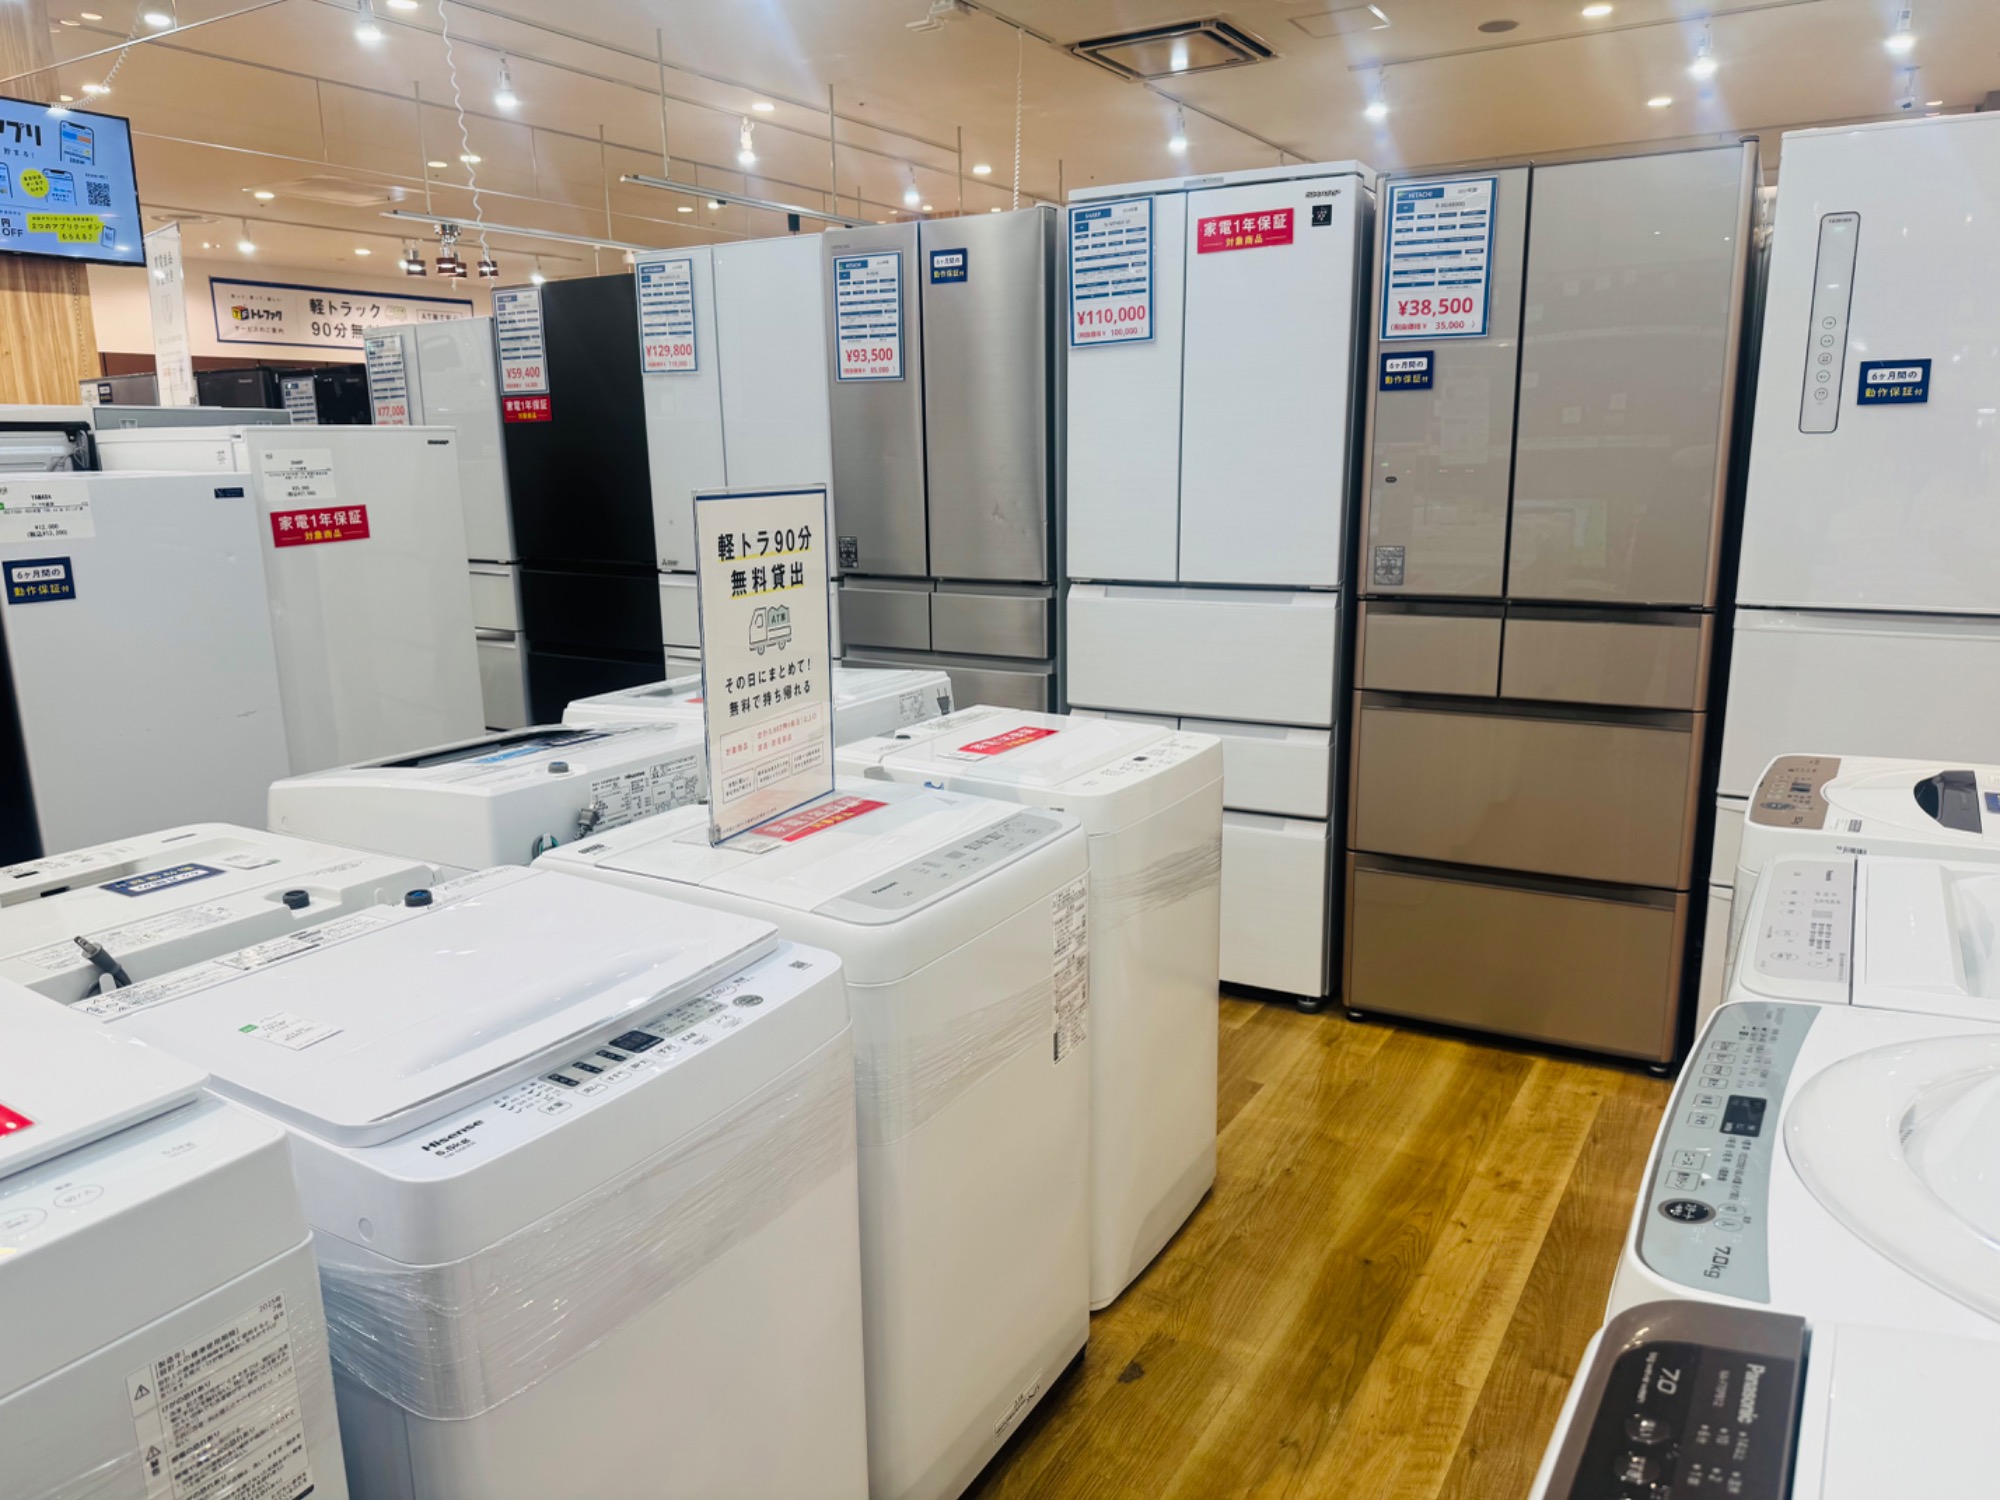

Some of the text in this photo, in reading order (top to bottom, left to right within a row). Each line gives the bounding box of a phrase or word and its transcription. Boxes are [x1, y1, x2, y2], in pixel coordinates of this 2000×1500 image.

[0, 119, 41, 146] プリ
[2, 228, 23, 237] OFF
[1203, 213, 1287, 237] 家電1年保証
[1225, 234, 1263, 247] 対象商品
[309, 298, 381, 318] 軽トラック
[1077, 305, 1146, 326] ¥110,000
[1398, 297, 1473, 317] ¥38,500
[311, 321, 380, 339] 90分無
[646, 344, 692, 357] ¥129,800
[846, 348, 893, 363] ¥93,500
[1872, 371, 1918, 381] 6ヶ月間の
[1865, 387, 1923, 398] 動作保証付
[278, 509, 363, 531] 家電1年保証
[305, 528, 342, 541] 対象商品
[717, 525, 812, 562] 軽トラ90分
[17, 568, 60, 579] 6ヶ月間の
[731, 561, 804, 597] 無料貸出
[14, 583, 69, 597] 動作保証付
[725, 658, 811, 694] その日にまとめて!
[729, 680, 811, 717] 無料で持ち帰れる
[422, 1119, 484, 1152] Hisense
[1704, 1246, 1731, 1279] 7.0kg
[1657, 1368, 1681, 1395] 7.0
[1737, 1363, 1766, 1424] Panasonic
